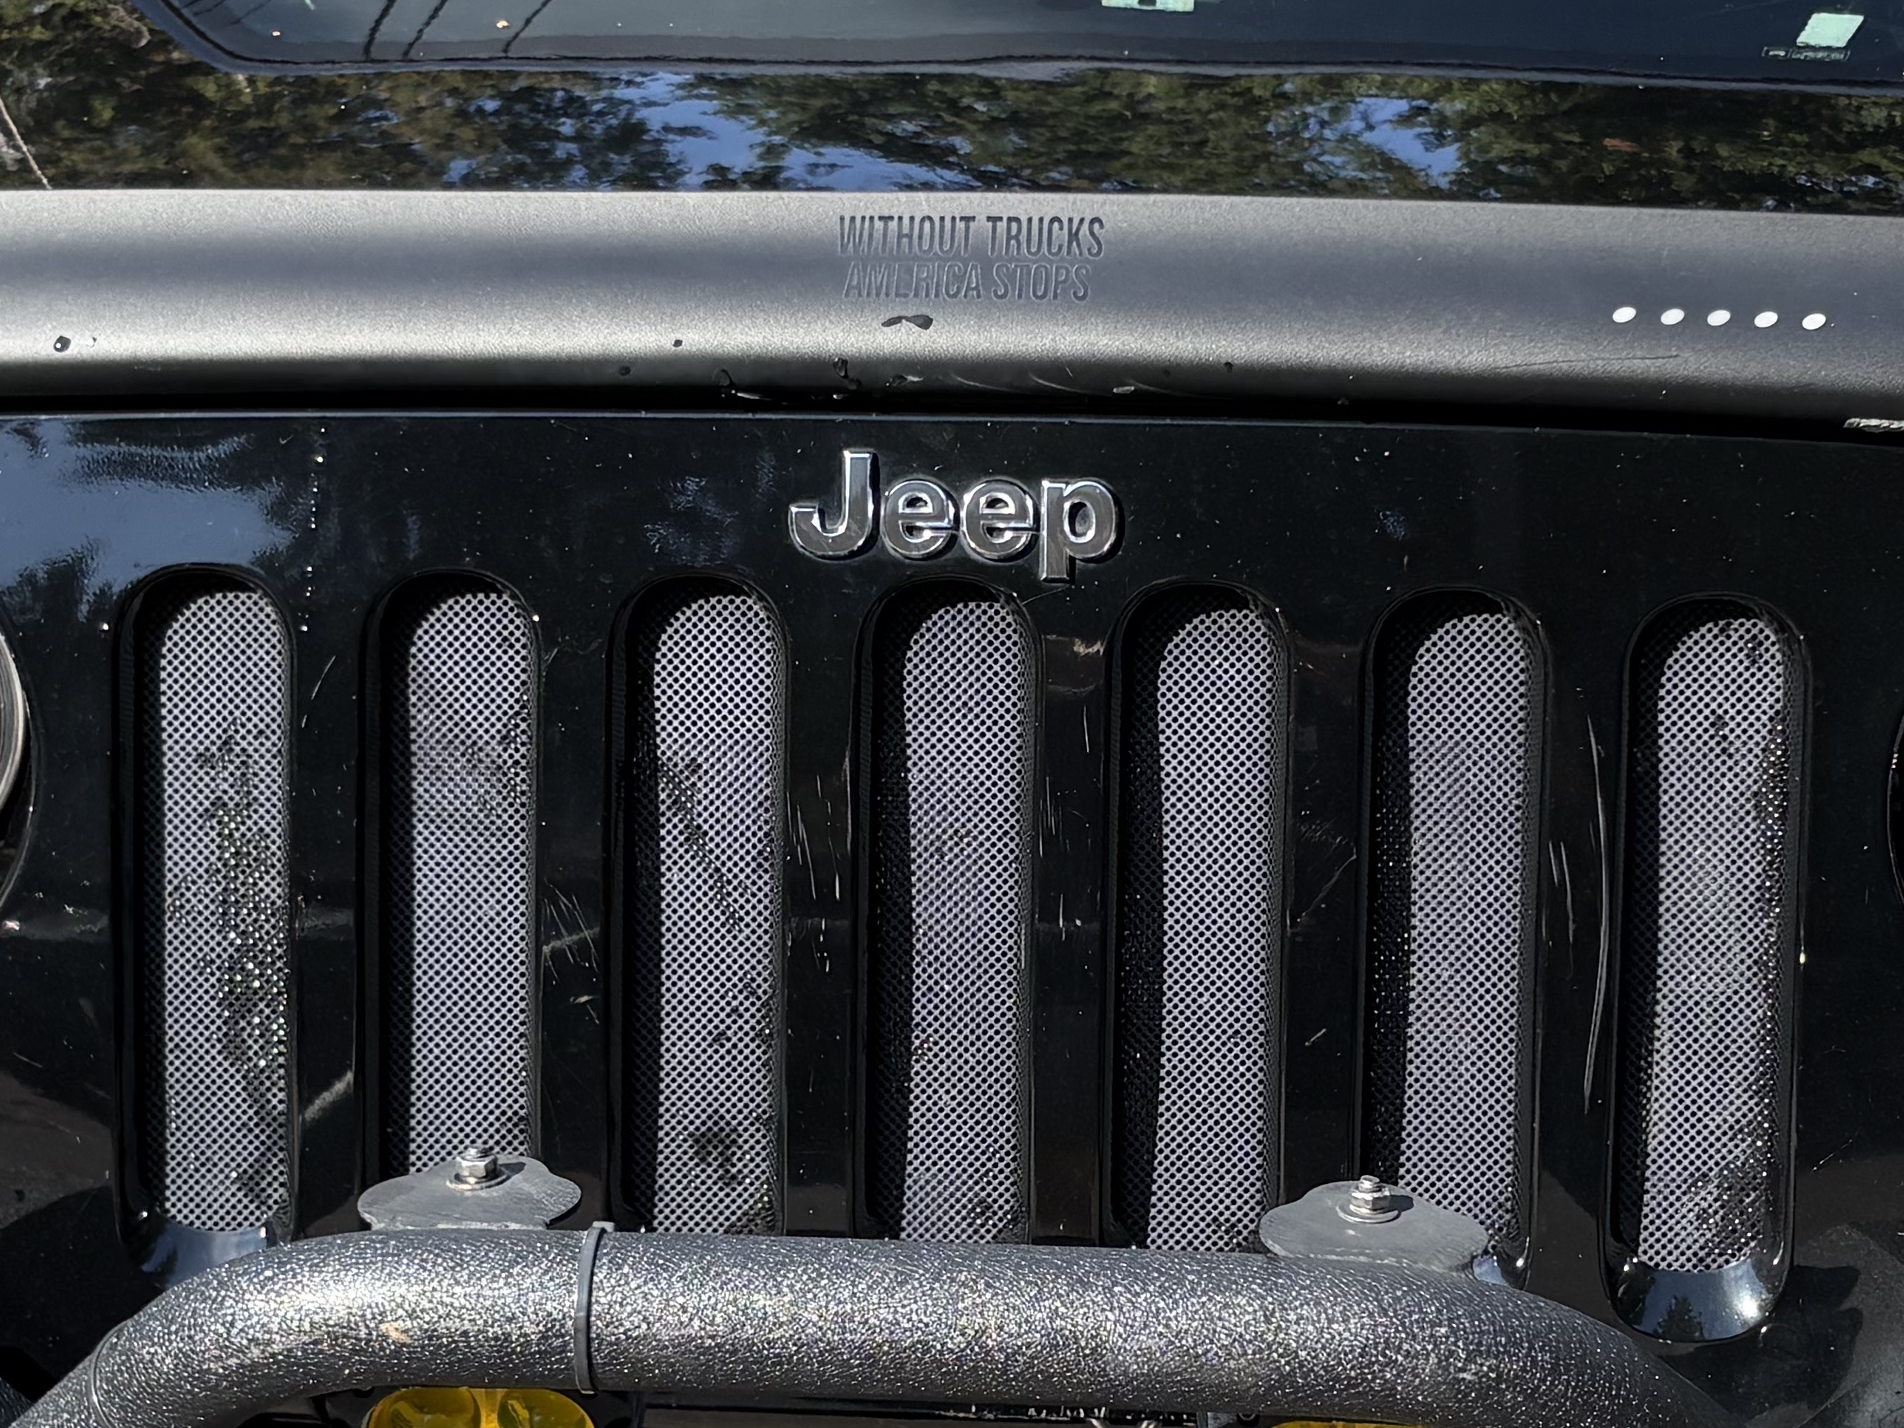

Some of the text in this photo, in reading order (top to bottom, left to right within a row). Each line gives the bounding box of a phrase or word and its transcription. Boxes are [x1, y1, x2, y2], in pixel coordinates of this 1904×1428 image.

[839, 215, 1105, 260] WITHOUT TRUCKS
[842, 261, 1092, 302] AMERICA STOPS
[787, 448, 1124, 582] Jeep
